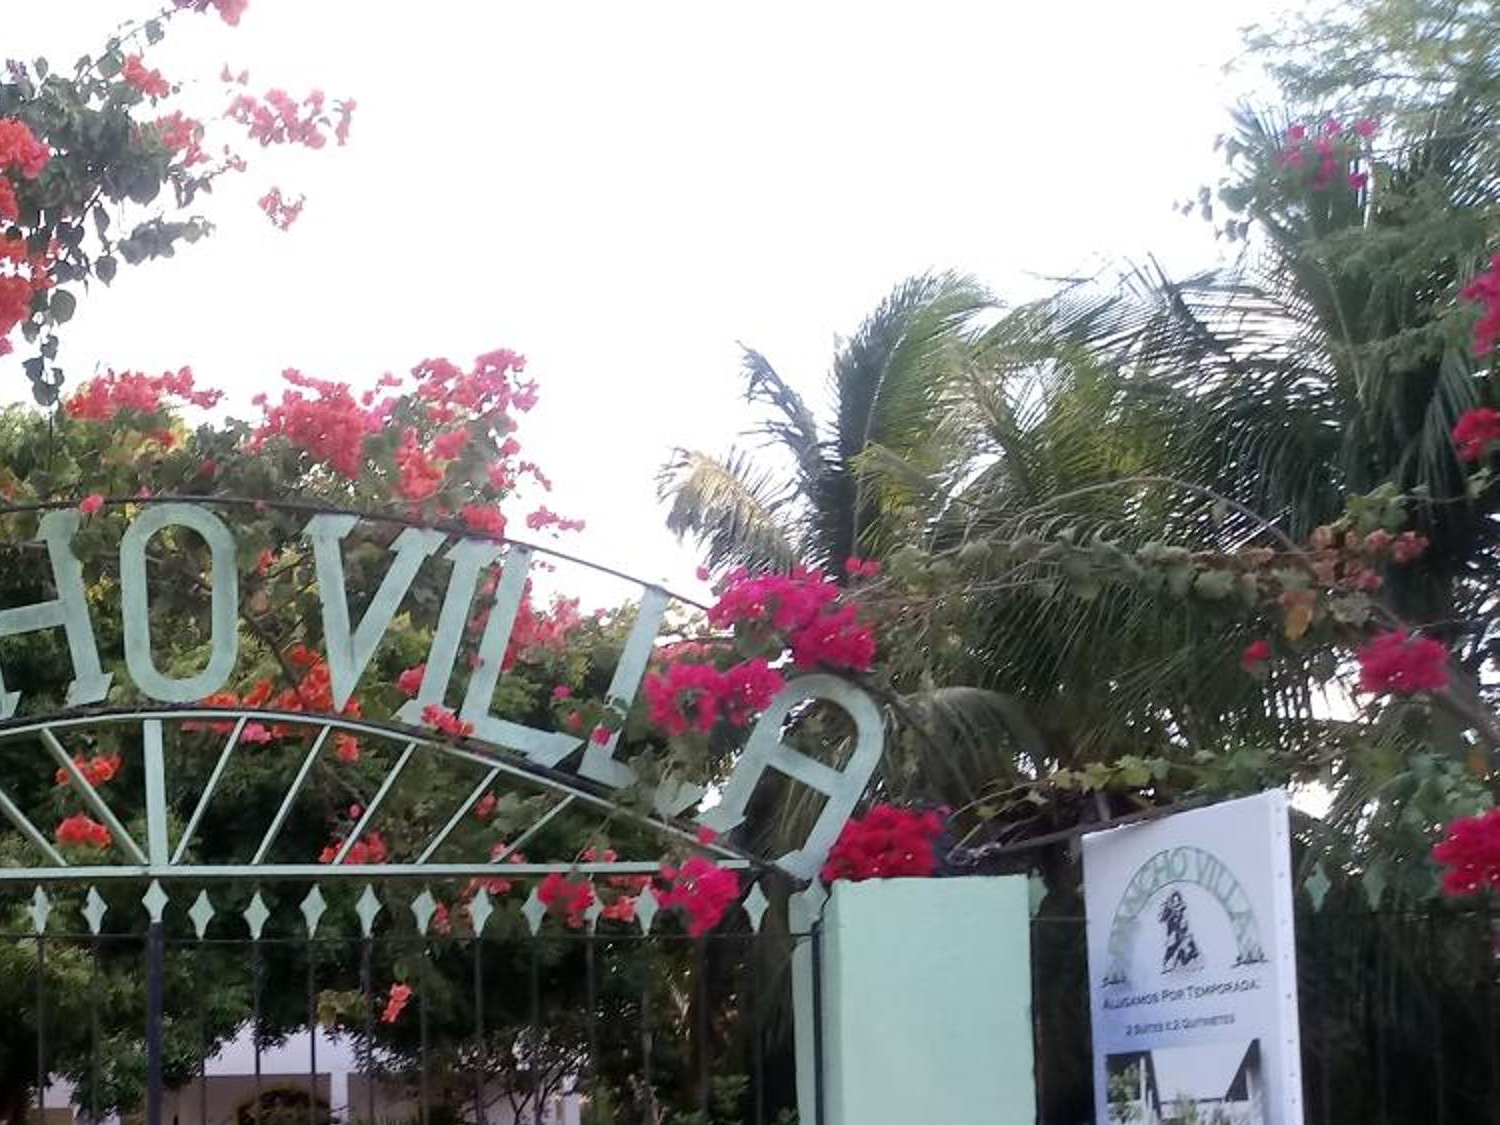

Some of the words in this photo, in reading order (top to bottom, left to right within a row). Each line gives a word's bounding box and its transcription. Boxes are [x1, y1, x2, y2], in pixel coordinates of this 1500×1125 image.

[301, 513, 886, 882] VILLA
[1161, 988, 1185, 1001] POR
[1186, 979, 1260, 999] TEMPORADA
